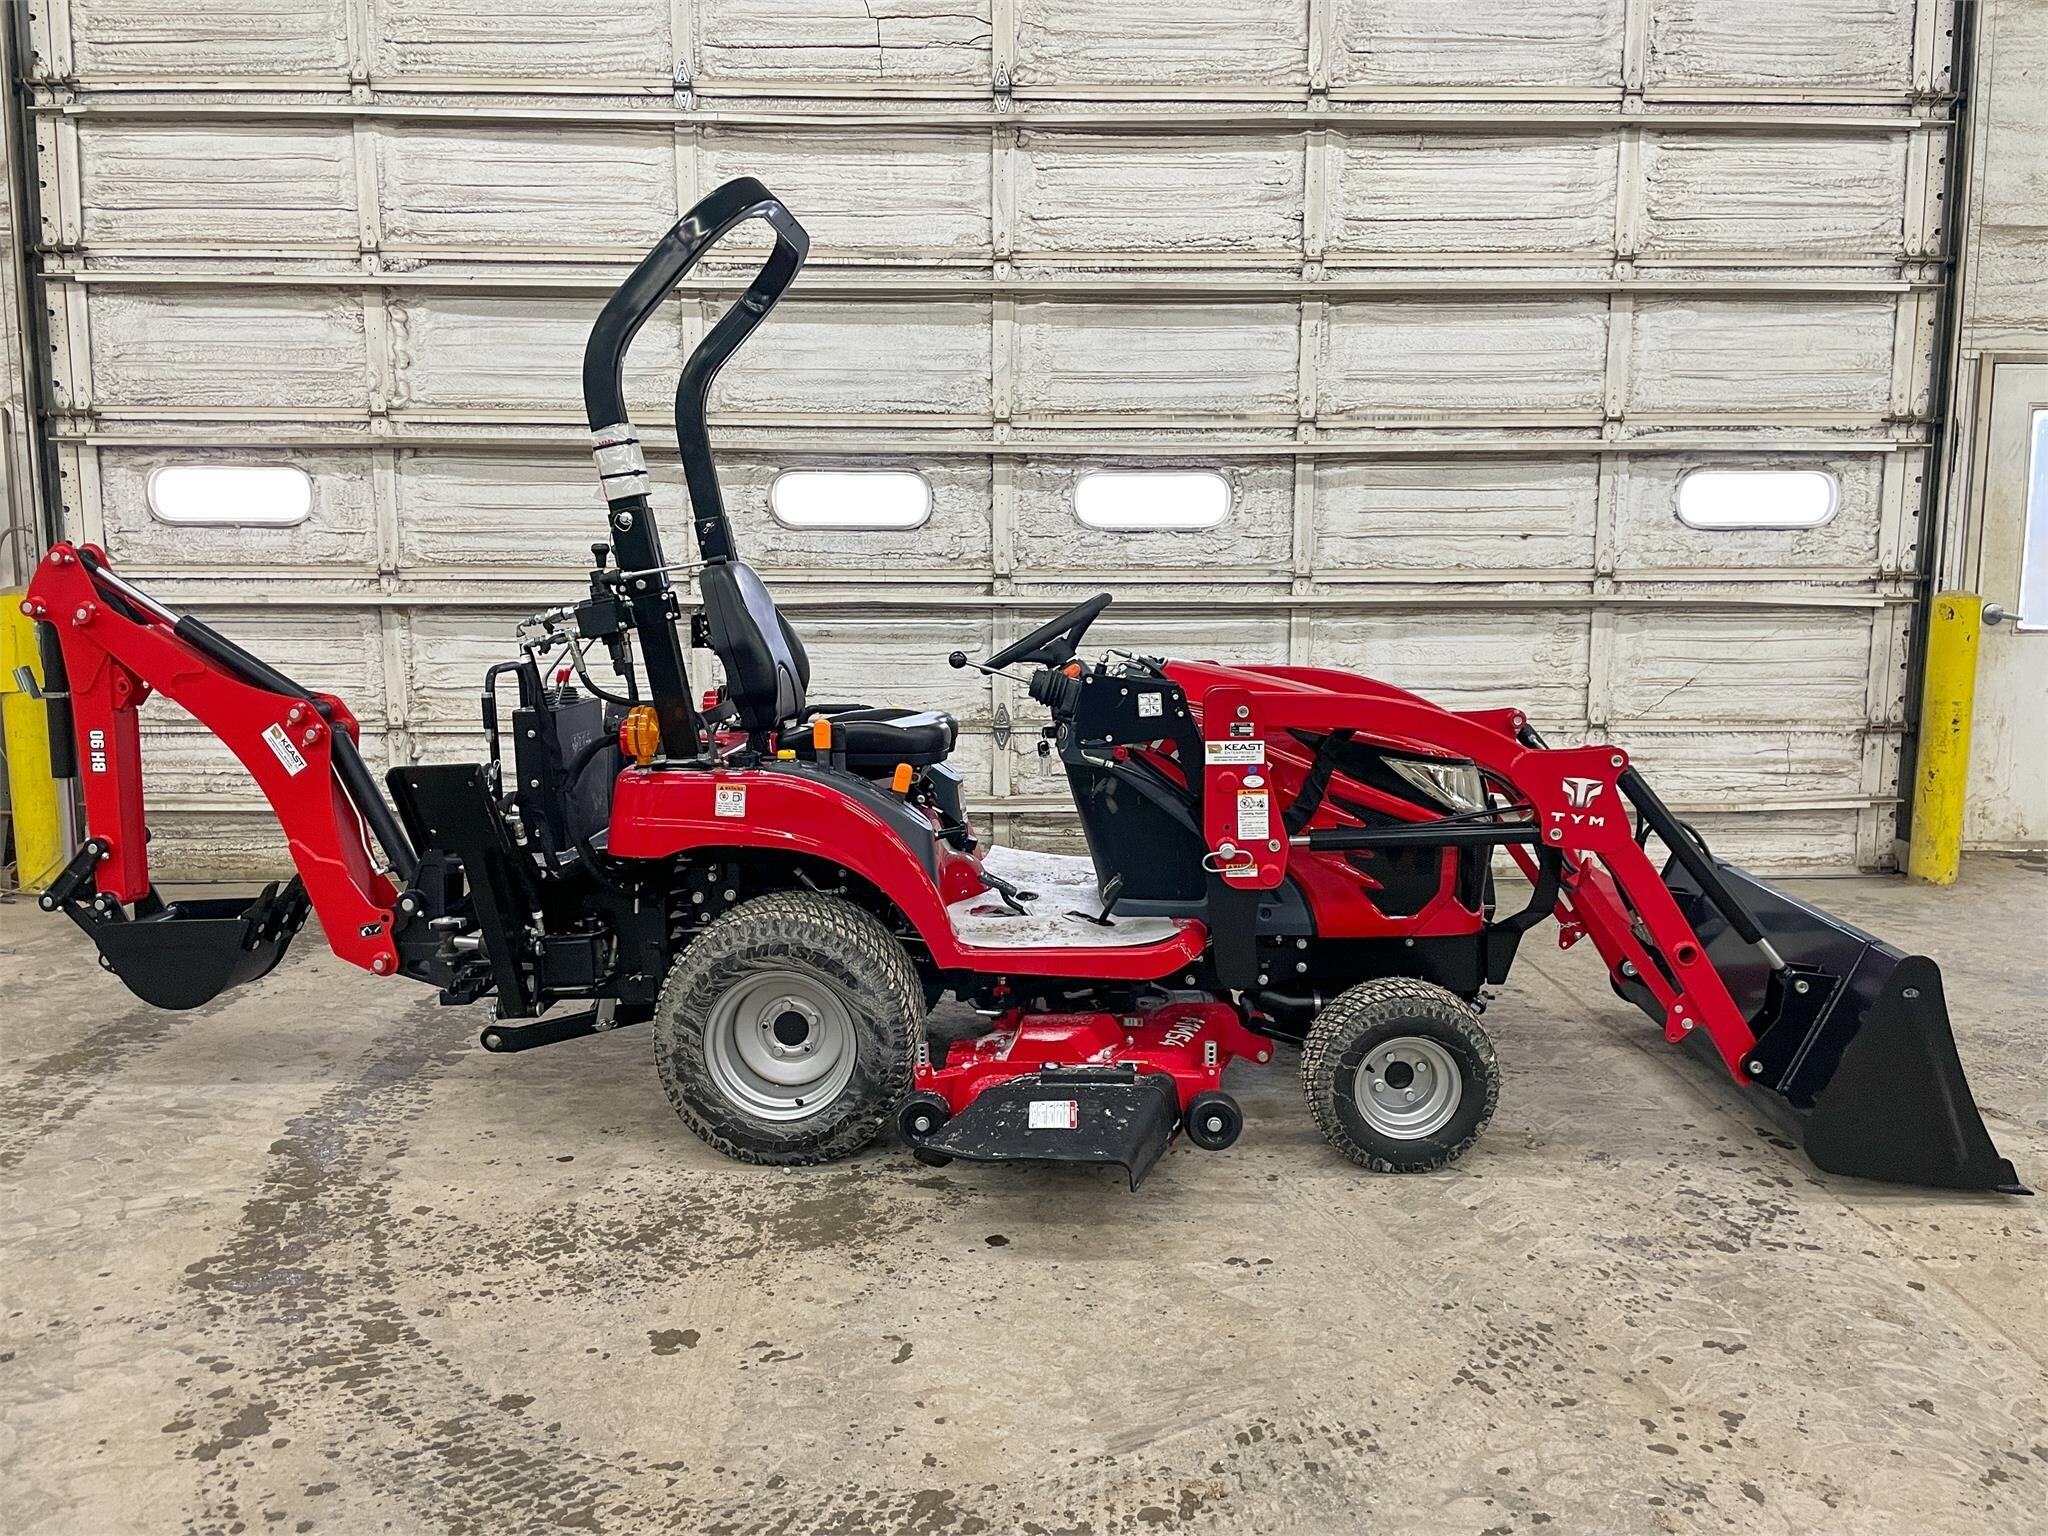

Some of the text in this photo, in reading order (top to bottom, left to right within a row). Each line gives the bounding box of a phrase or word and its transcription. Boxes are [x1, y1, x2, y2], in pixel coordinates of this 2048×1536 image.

[89, 729, 107, 773] BH 90
[280, 738, 305, 767] KEAST
[1224, 743, 1263, 751] KEAST
[1551, 811, 1605, 827] TYM
